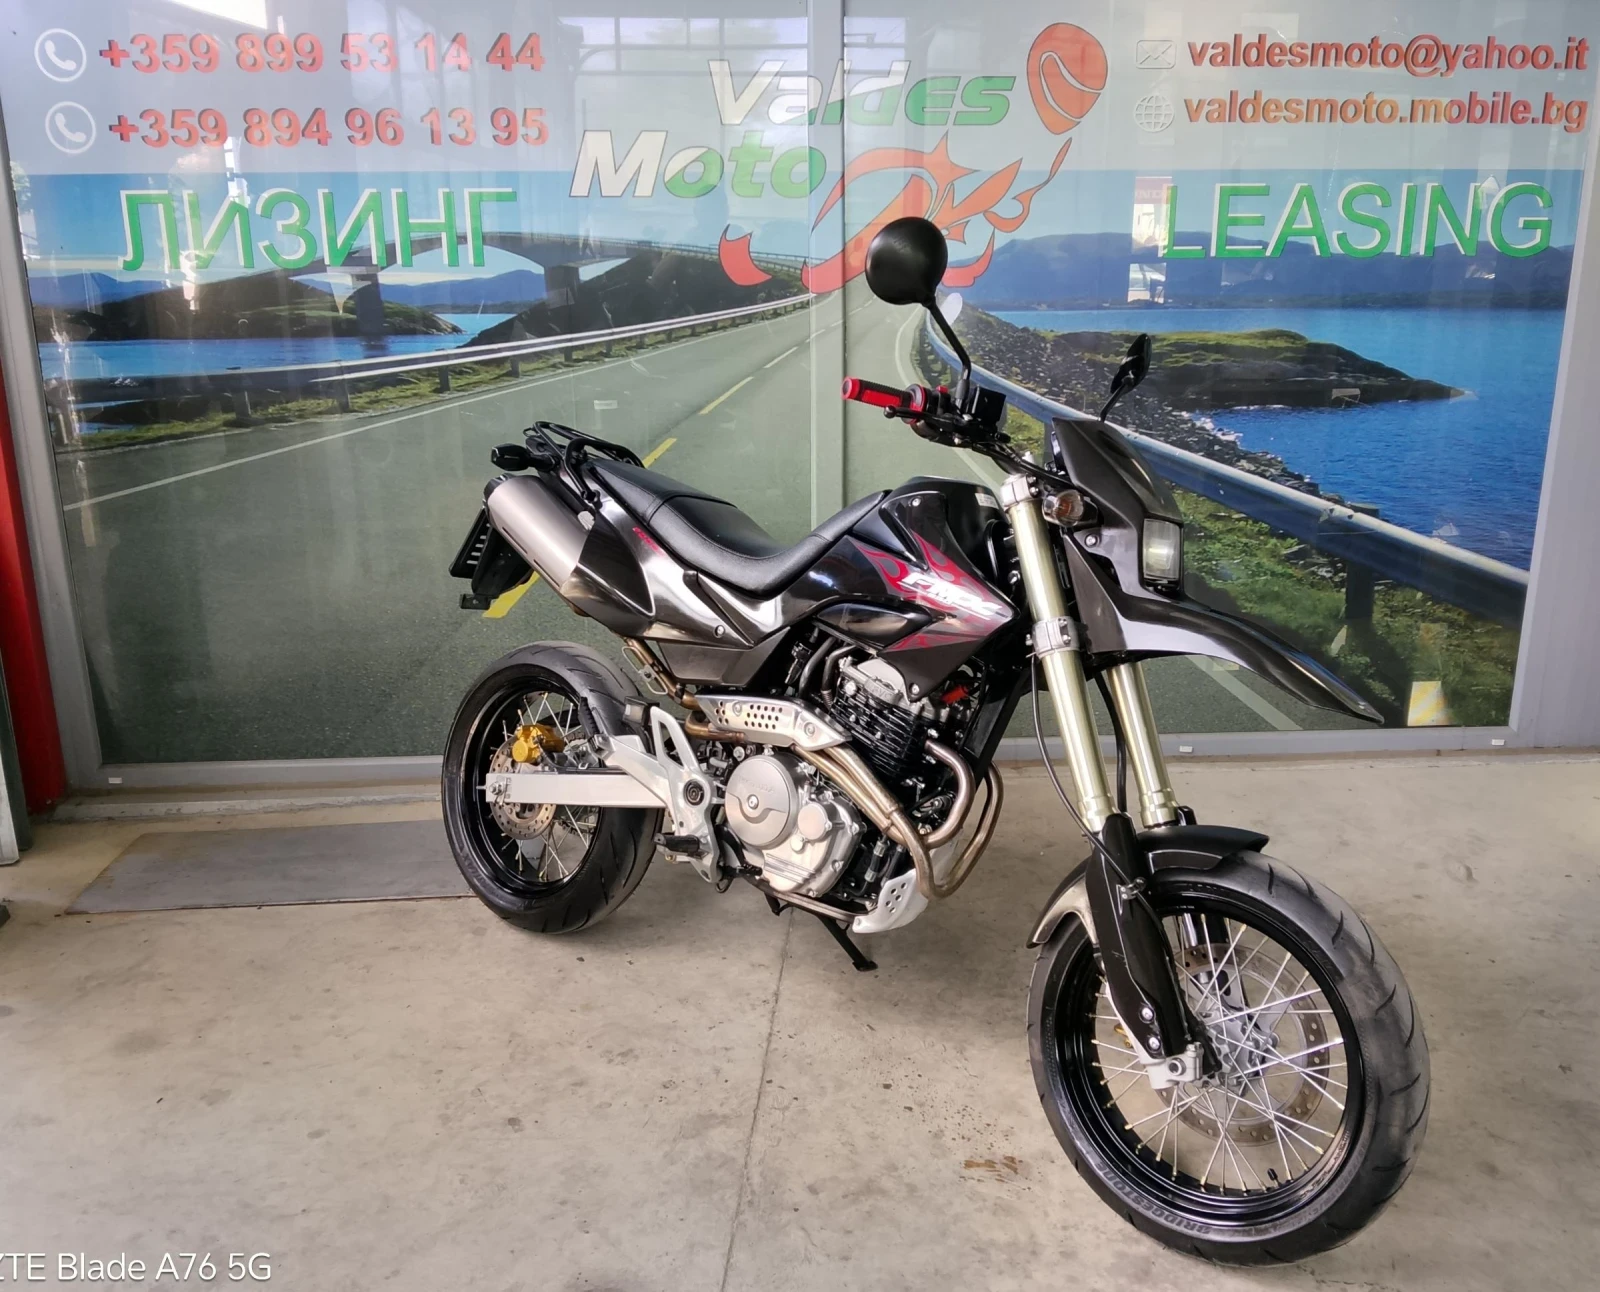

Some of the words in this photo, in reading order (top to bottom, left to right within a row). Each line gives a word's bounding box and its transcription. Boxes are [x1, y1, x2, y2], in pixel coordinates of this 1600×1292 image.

[99, 33, 219, 74] +359
[235, 33, 323, 74] 899
[340, 33, 399, 73] 53
[415, 32, 471, 72] 14
[486, 32, 546, 72] 44
[1187, 33, 1589, 77] valdesmoto@yahoo.it
[707, 59, 1017, 126] Valdes
[1184, 90, 1588, 133] valdesmoto.mobile.bg
[108, 108, 228, 148] +359
[243, 108, 332, 147] 894
[345, 107, 404, 147] 96
[420, 107, 476, 146] 13
[492, 108, 549, 146] 95
[568, 130, 827, 198] Moto
[117, 187, 517, 271] ЛИЗИНГ
[1157, 181, 1554, 260] LEASING
[1094, 1163, 1213, 1235] BRIDGESTONE
